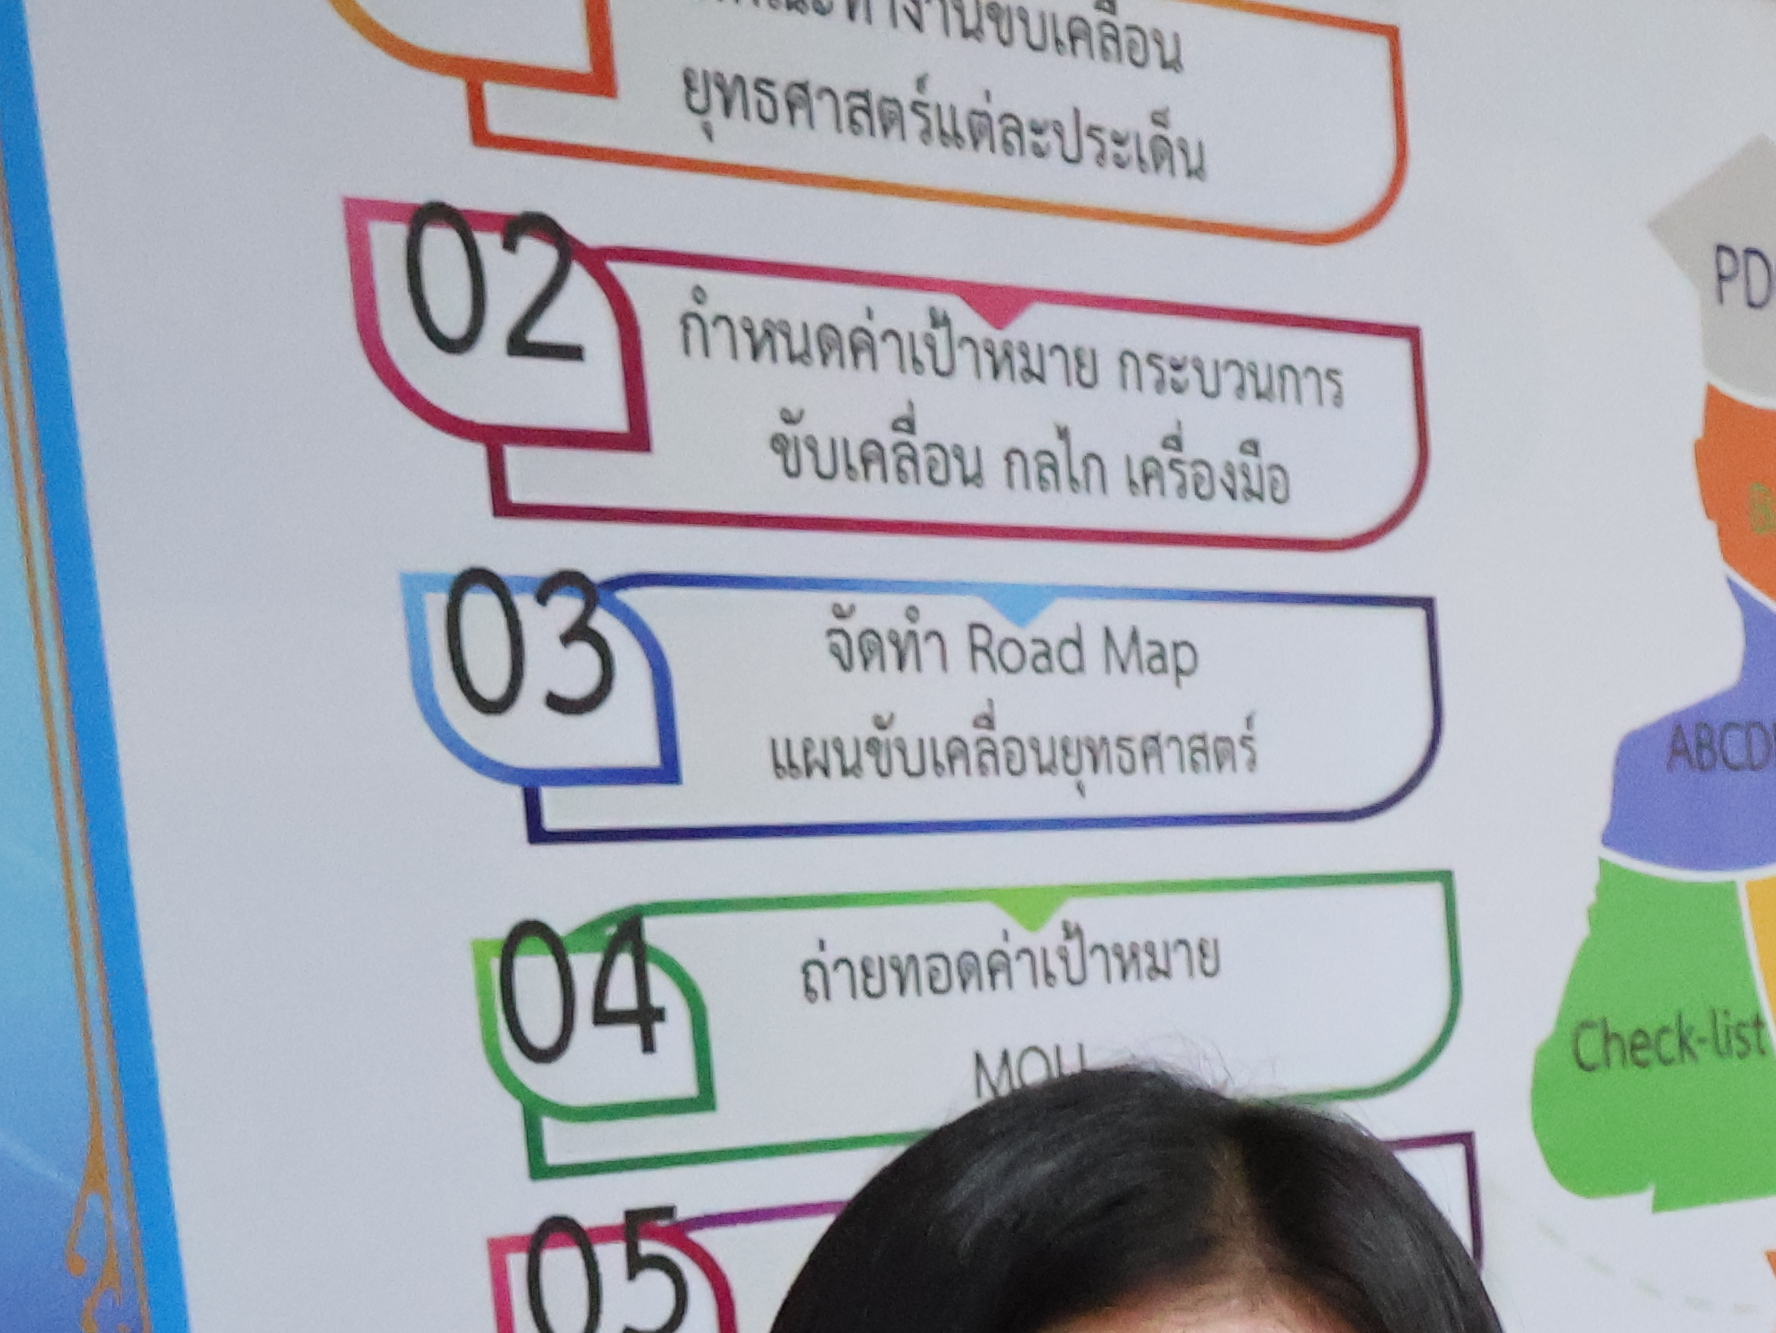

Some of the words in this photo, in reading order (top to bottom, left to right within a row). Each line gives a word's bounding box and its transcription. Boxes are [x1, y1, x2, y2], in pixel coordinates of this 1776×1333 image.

[682, 66, 1207, 182] ยุทธศาสตร์แต่ละประเด็น
[404, 200, 587, 361] 02
[681, 285, 1099, 391] กำหนดค่าเป้าหมาย
[1117, 346, 1345, 409] กระบวนการ
[769, 399, 983, 490] ขับเคลื่อน
[1003, 424, 1107, 496] กลไก
[1126, 418, 1290, 505] เครื่องมือ
[444, 566, 615, 716] 03
[825, 604, 948, 676] จัดทำ
[969, 623, 1085, 677] Road
[1104, 627, 1200, 684] Map
[769, 698, 1260, 798] แผนขับเคลื่อนยุทธศาสตร์
[498, 914, 666, 1065] 04
[800, 921, 1221, 1004] ถ่ายทอดค่าเป้าหมาย
[1571, 1007, 1767, 1073] Check-list
